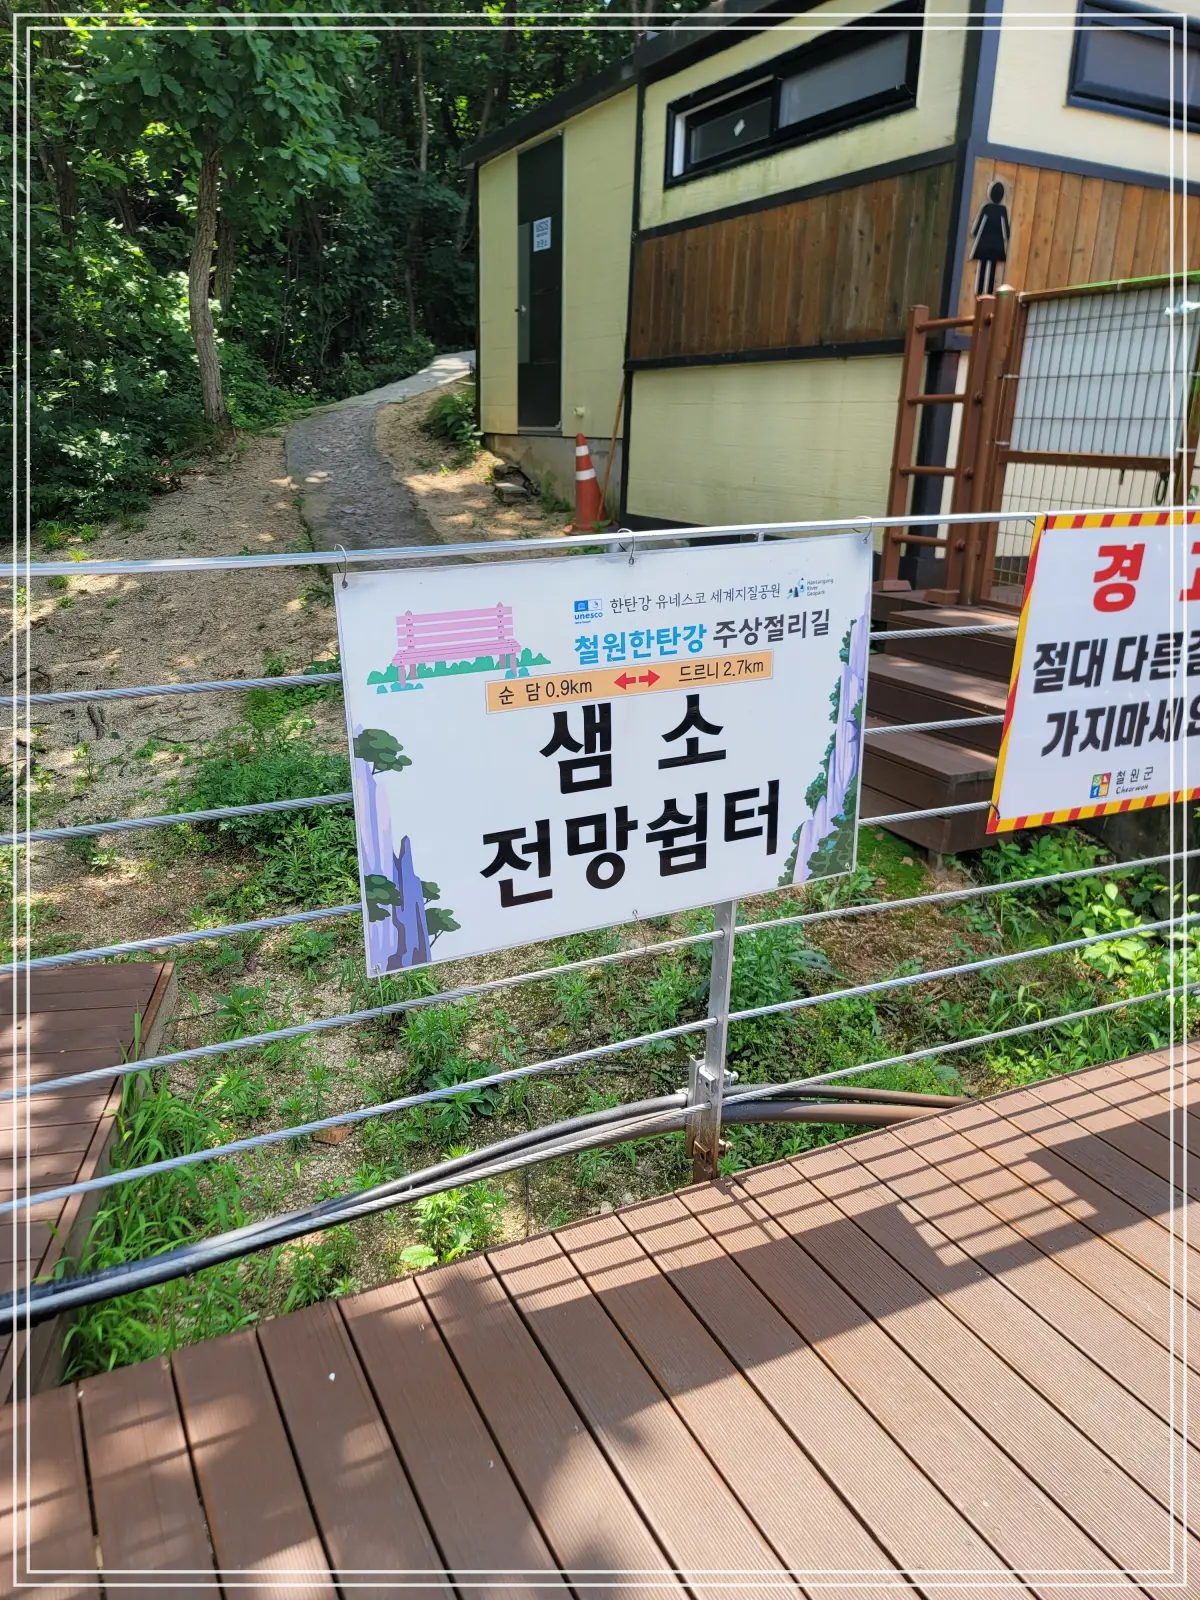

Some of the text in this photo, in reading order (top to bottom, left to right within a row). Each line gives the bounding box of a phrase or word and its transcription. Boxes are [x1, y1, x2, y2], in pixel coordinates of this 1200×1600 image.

[609, 582, 781, 614] 한탄강 유네스코 세계지질공원
[574, 612, 603, 620] unesco
[574, 608, 830, 666] 철원한탄강 주상절리길
[678, 660, 764, 683] 드르니 2.7km
[1032, 638, 1109, 694] 절대
[545, 679, 593, 699] 0.9km
[479, 779, 780, 909] 전망쉼터
